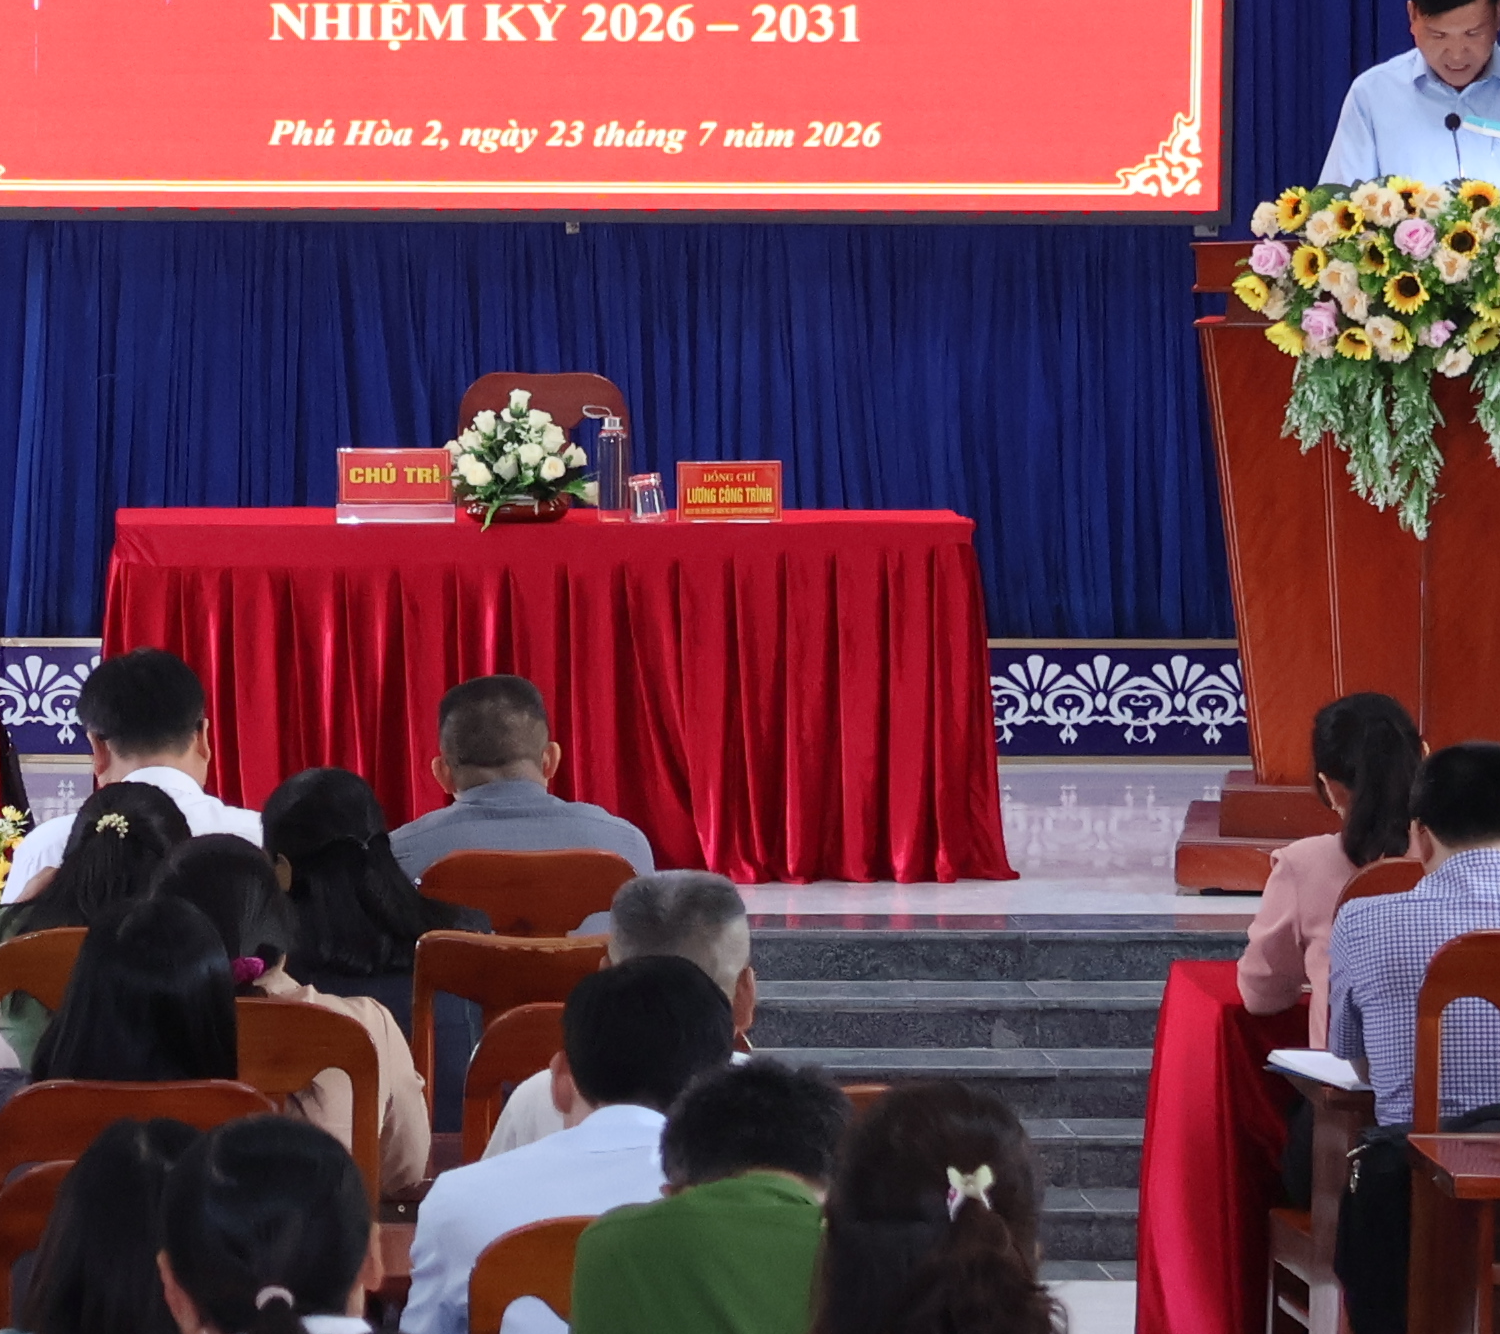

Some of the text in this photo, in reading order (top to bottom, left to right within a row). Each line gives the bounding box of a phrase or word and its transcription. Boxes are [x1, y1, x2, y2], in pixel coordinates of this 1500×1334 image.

[581, 3, 694, 42] 2026
[751, 4, 860, 42] 2031
[268, 119, 881, 154] Phú Hòa 2, ngày 23 tháng 7 năm 2026
[349, 462, 440, 484] CHỦ TRÌ
